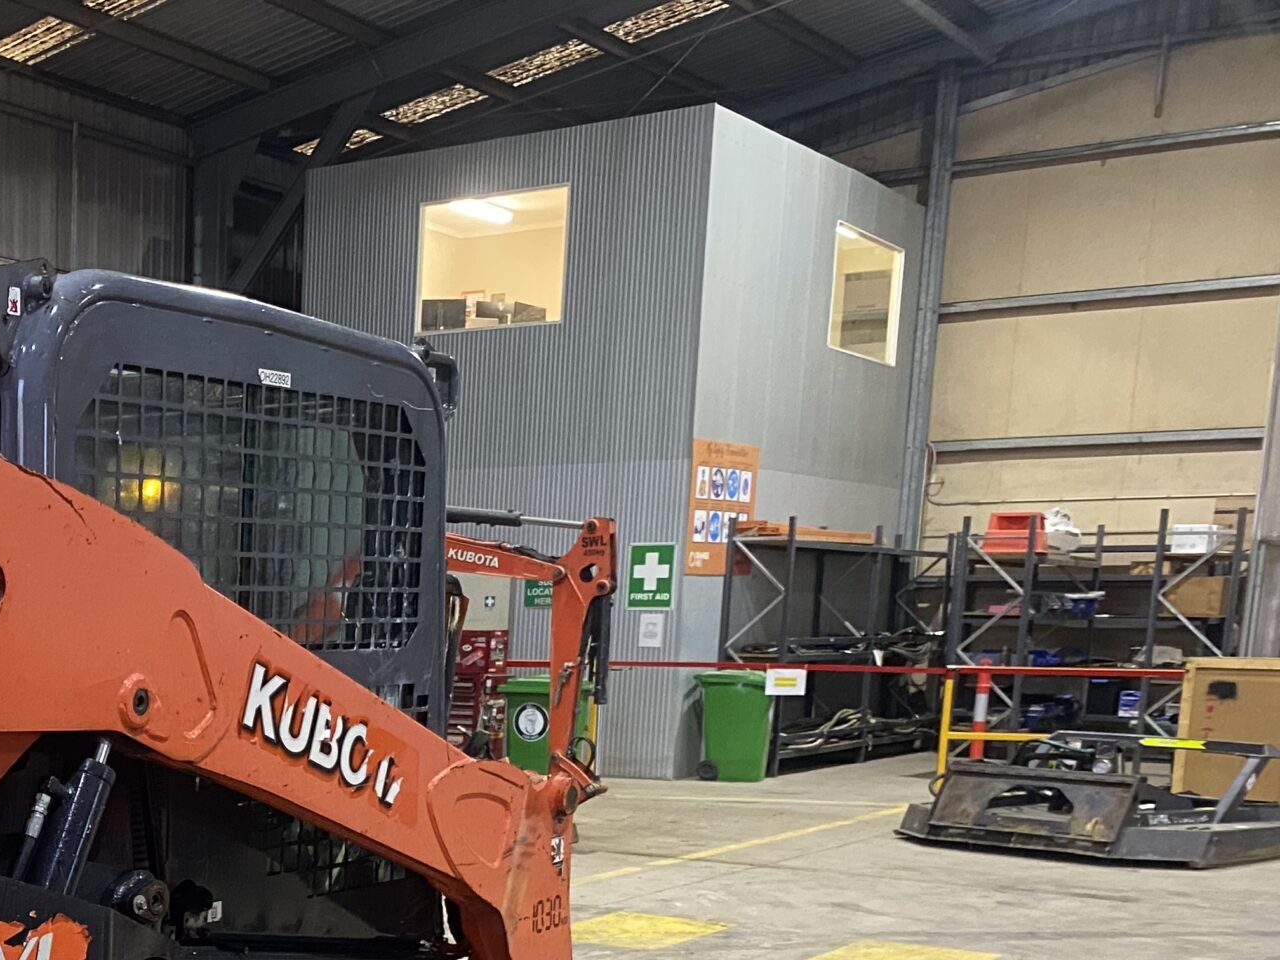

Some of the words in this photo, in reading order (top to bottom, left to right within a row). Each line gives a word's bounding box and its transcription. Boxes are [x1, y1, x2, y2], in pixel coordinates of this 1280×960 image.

[581, 535, 607, 548] SWL
[447, 547, 500, 568] KUBOTA
[527, 588, 553, 596] LOCAT
[630, 592, 654, 600] FIRST
[654, 592, 670, 600] AID
[534, 597, 552, 605] HER
[243, 662, 404, 804] KUBO
